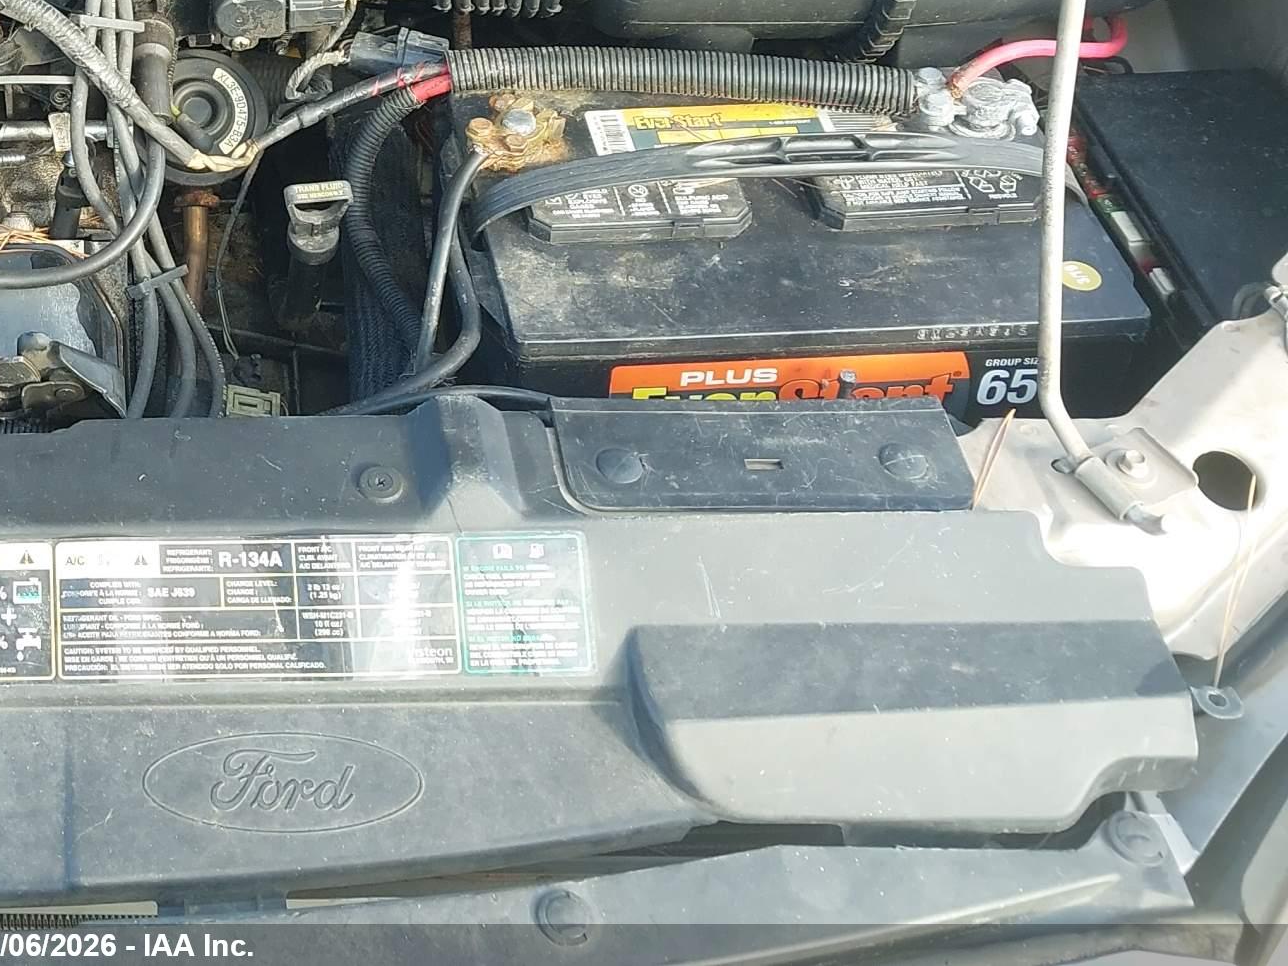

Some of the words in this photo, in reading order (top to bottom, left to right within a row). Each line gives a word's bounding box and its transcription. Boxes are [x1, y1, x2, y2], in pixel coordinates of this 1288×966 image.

[633, 112, 723, 130] EverStart
[985, 358, 1021, 367] GROUP
[1024, 357, 1040, 365] SIZ
[680, 367, 778, 387] PLUS
[976, 369, 1039, 405] 65
[65, 556, 86, 566] A/C
[218, 550, 283, 568] R-134A
[147, 587, 169, 597] SAE
[314, 620, 323, 628] 10
[209, 748, 357, 811] Ford
